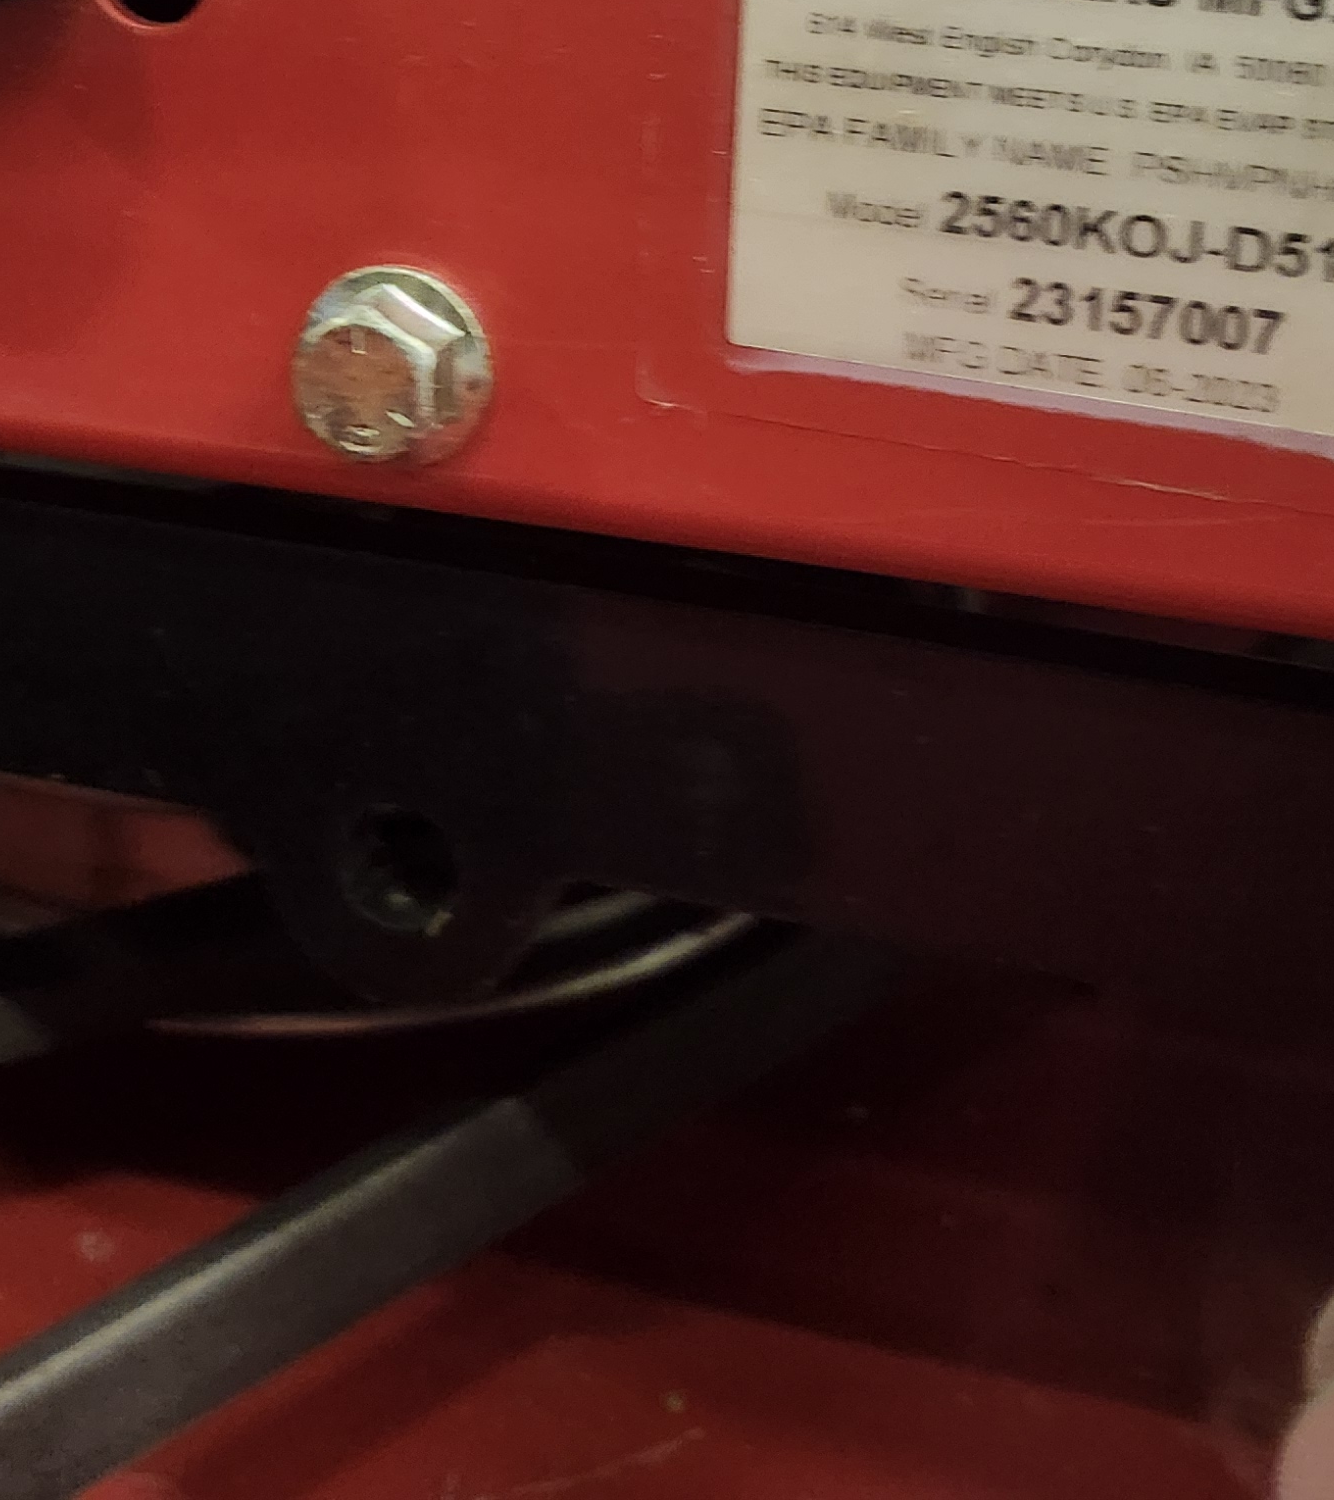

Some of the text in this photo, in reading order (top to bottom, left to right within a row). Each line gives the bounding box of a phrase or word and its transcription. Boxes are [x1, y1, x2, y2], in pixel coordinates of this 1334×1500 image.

[764, 58, 821, 83] THIS
[828, 66, 984, 99] EQUIPMENT
[988, 83, 1084, 113] MEETS
[1149, 100, 1208, 123] EPA
[759, 107, 832, 141] EPA
[843, 117, 985, 158] FAMILY
[1008, 276, 1285, 356] 23157007
[903, 331, 989, 369] MFG
